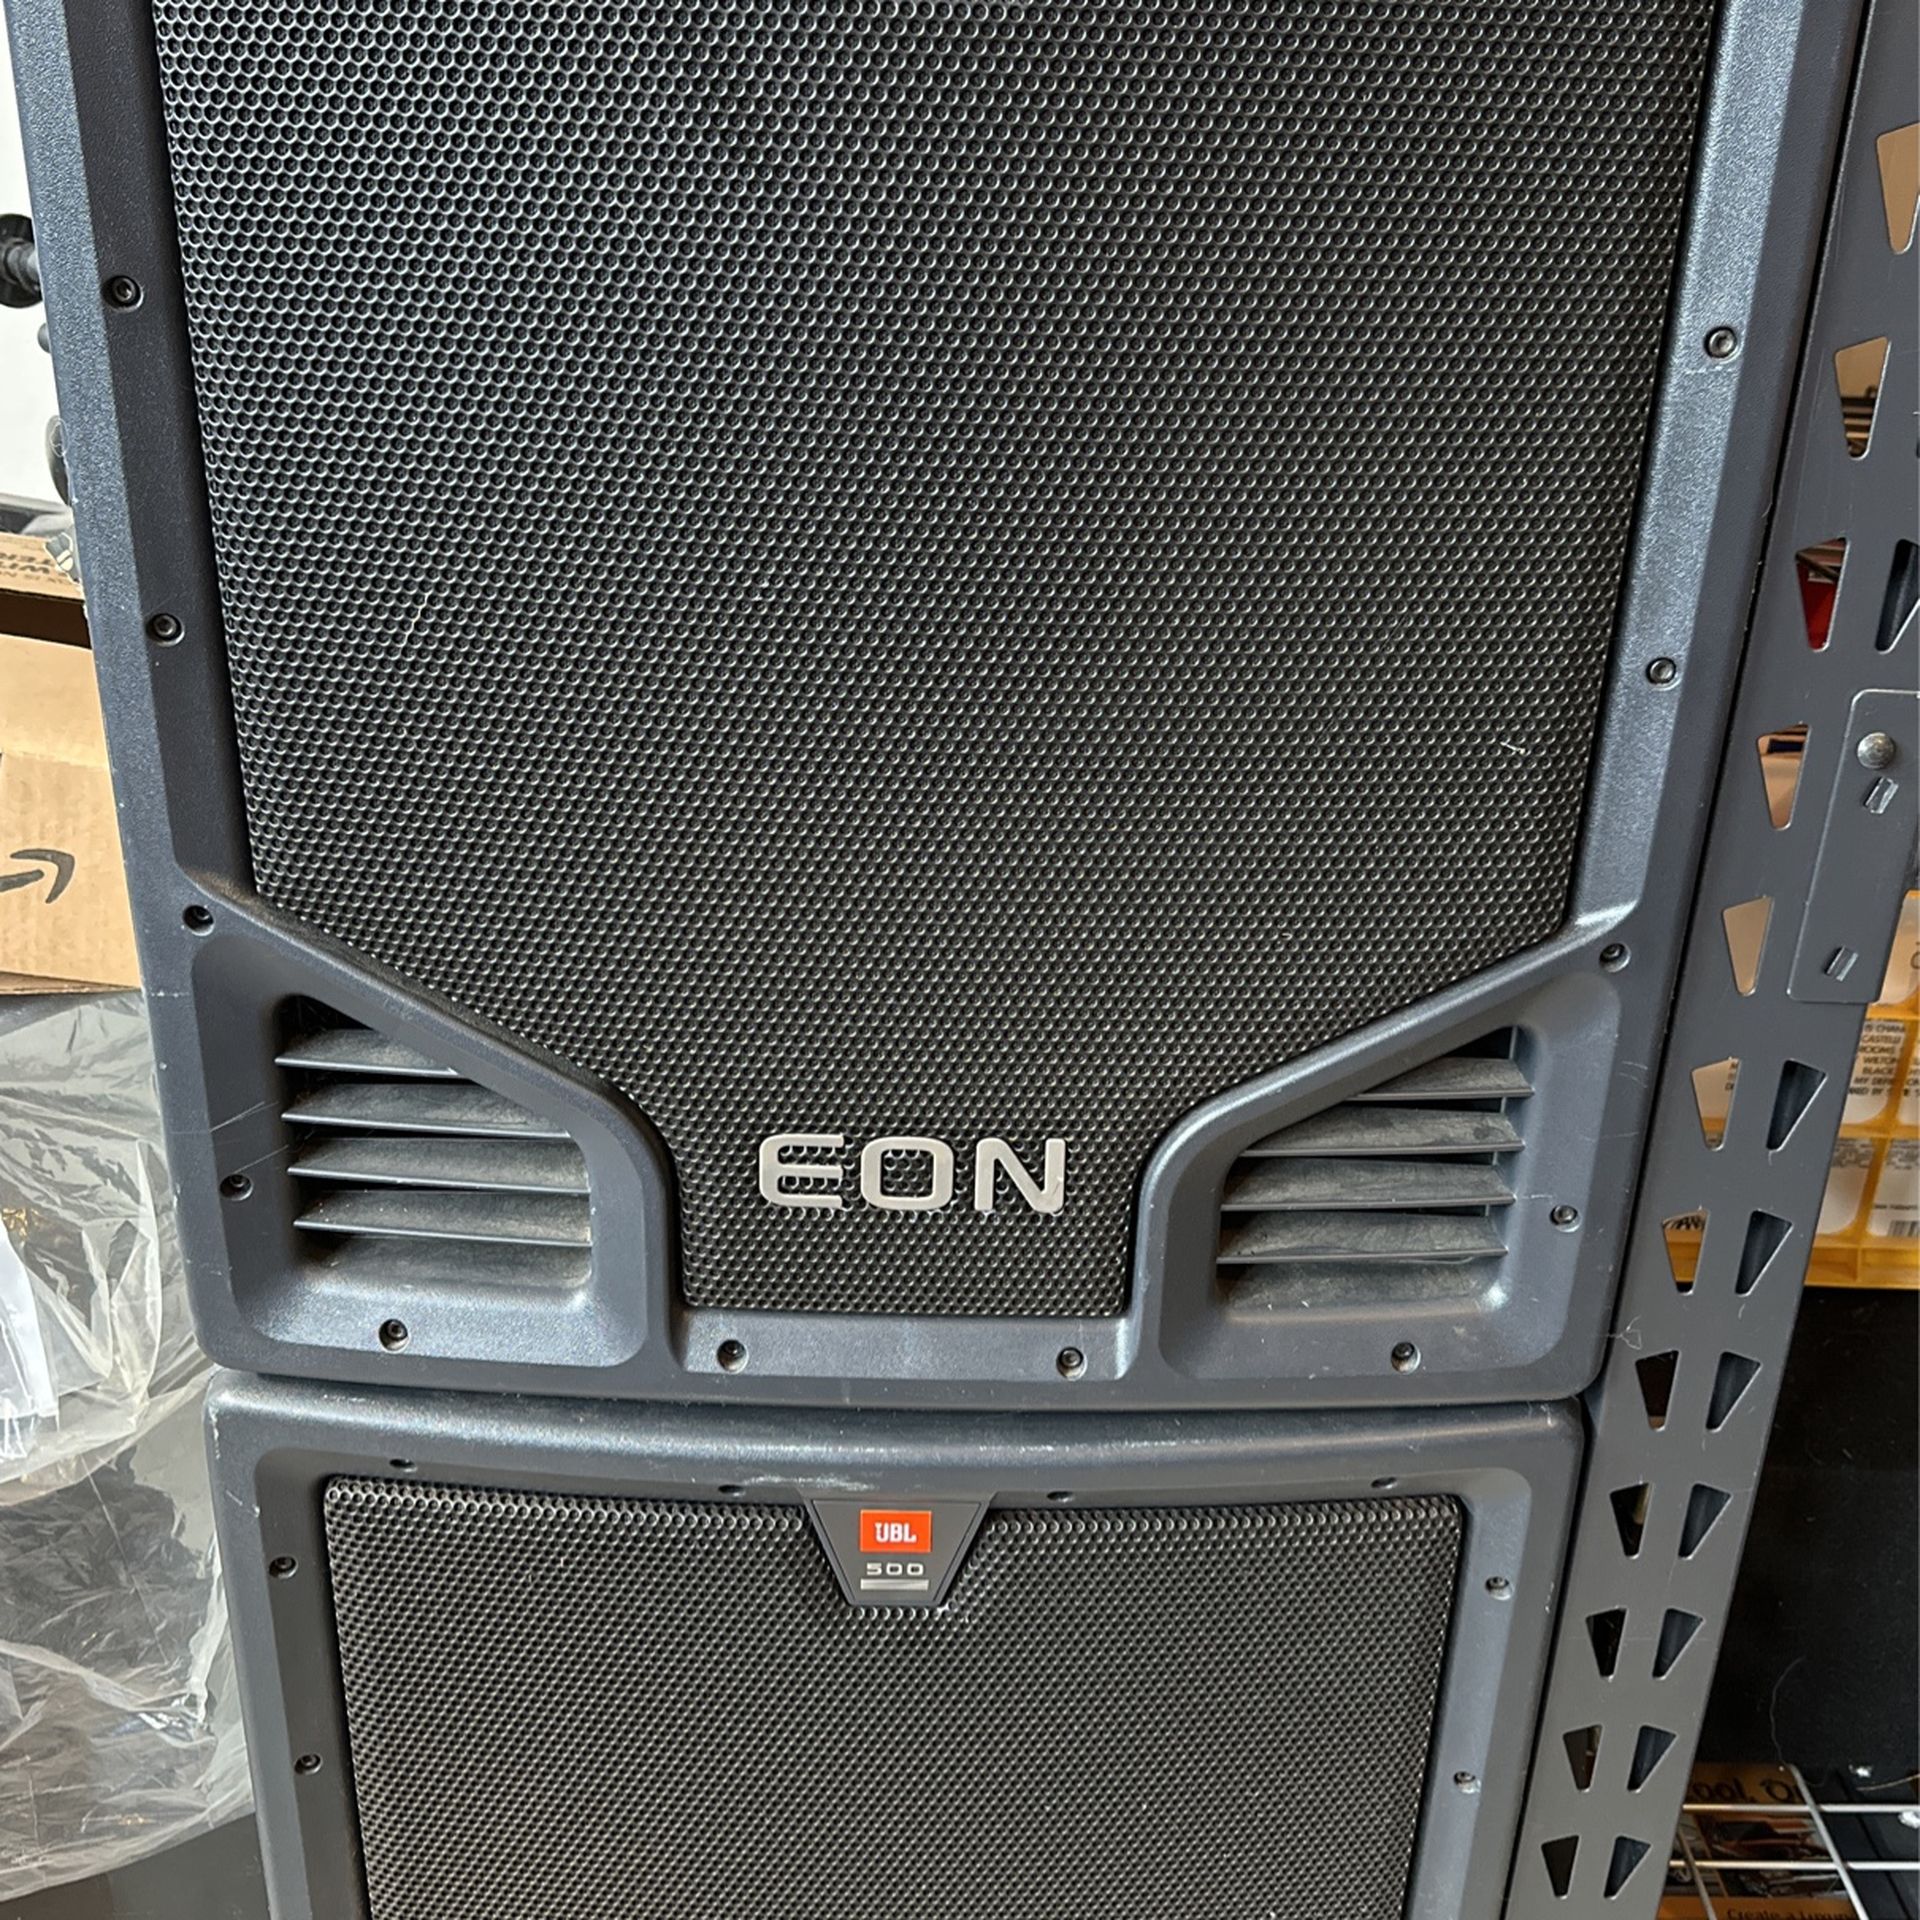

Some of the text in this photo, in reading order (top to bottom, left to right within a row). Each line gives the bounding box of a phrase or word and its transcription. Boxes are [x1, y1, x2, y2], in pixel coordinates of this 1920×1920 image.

[759, 1133, 1066, 1213] EON
[874, 1522, 917, 1544] JBL
[866, 1561, 925, 1576] 500
